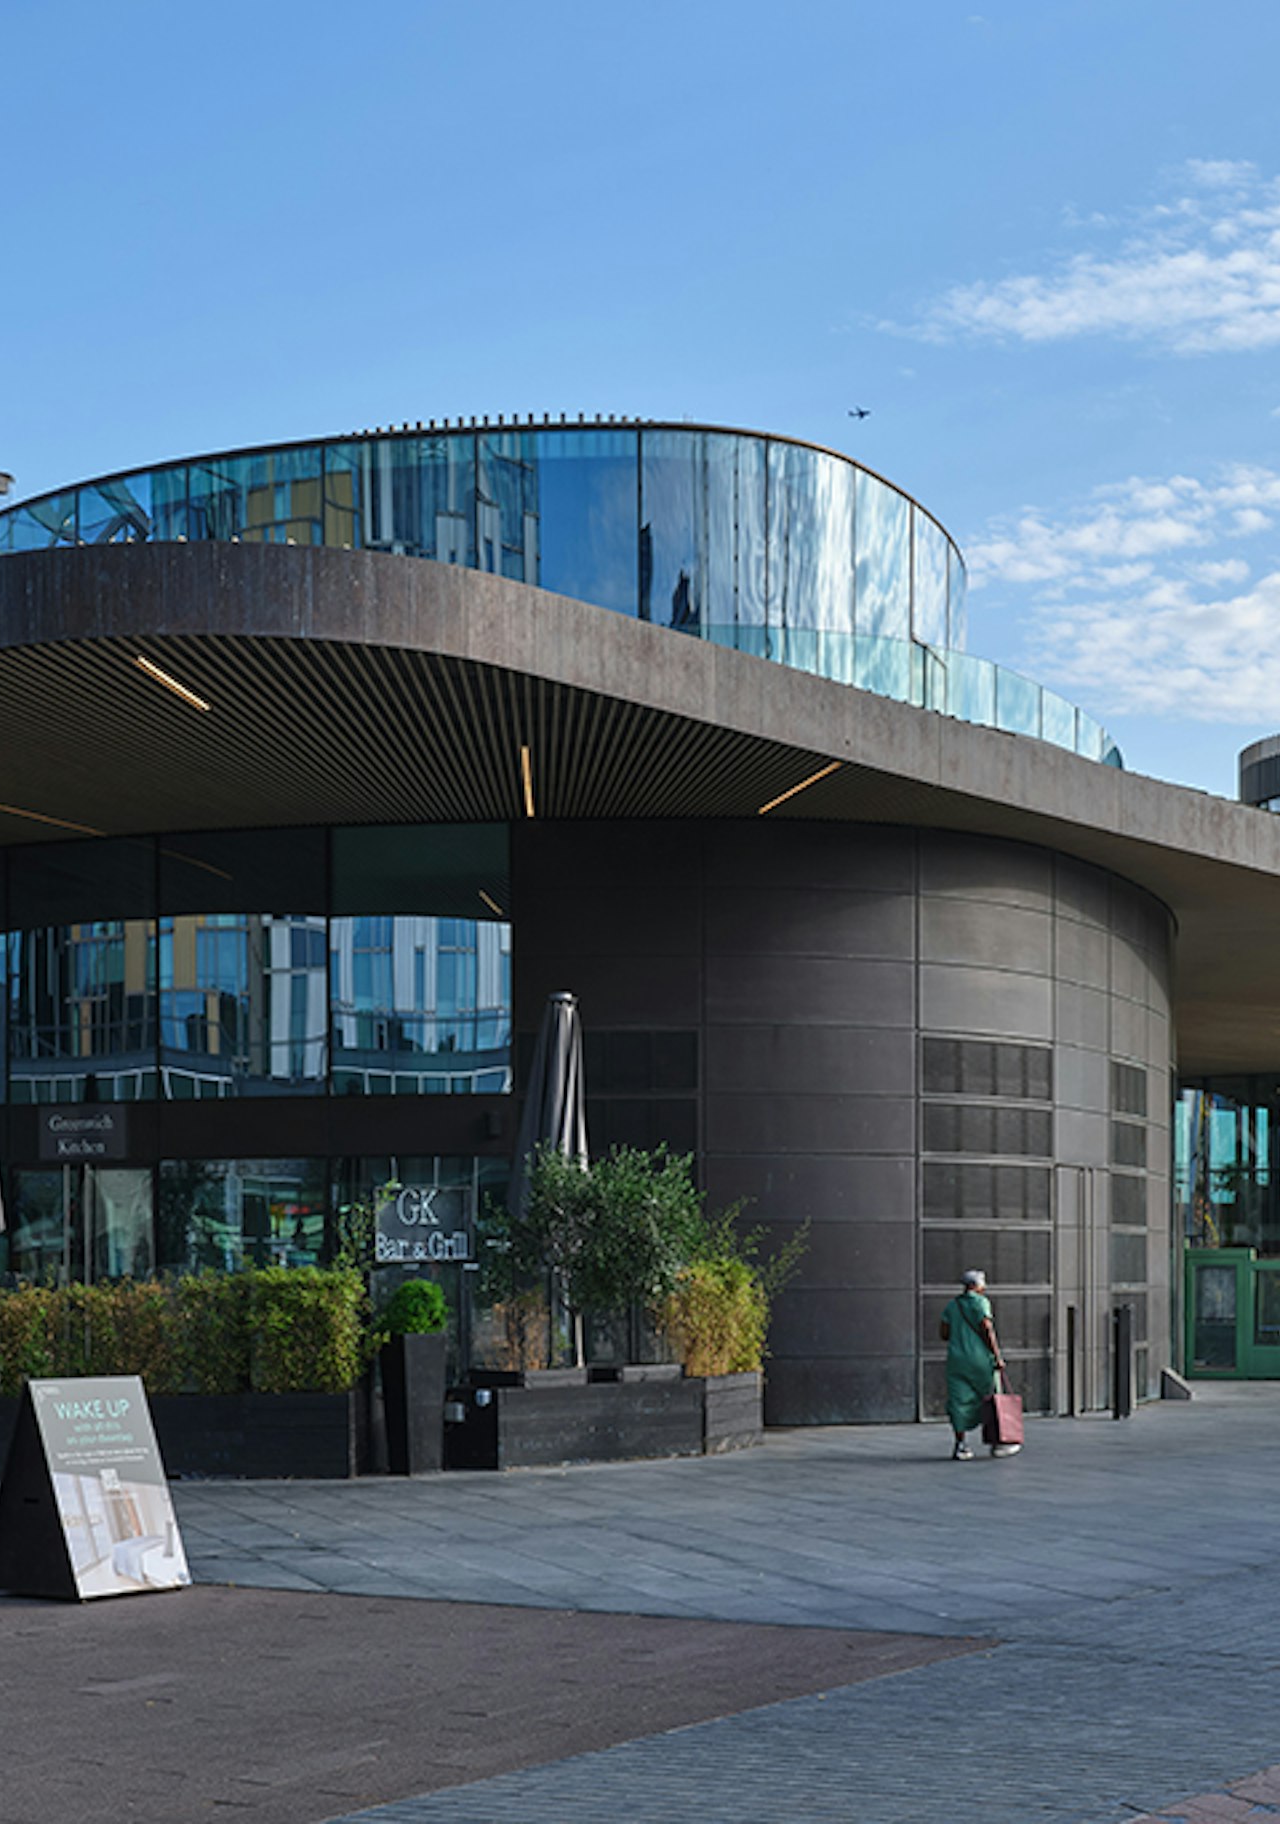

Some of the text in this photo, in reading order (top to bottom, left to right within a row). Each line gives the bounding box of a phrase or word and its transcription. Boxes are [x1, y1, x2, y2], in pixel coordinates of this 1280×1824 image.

[48, 1114, 114, 1132] Greenwich
[58, 1139, 105, 1155] Kitchen
[396, 1188, 440, 1226] GK
[376, 1231, 468, 1260] Bar & Grill
[53, 1398, 130, 1420] WAKE UP
